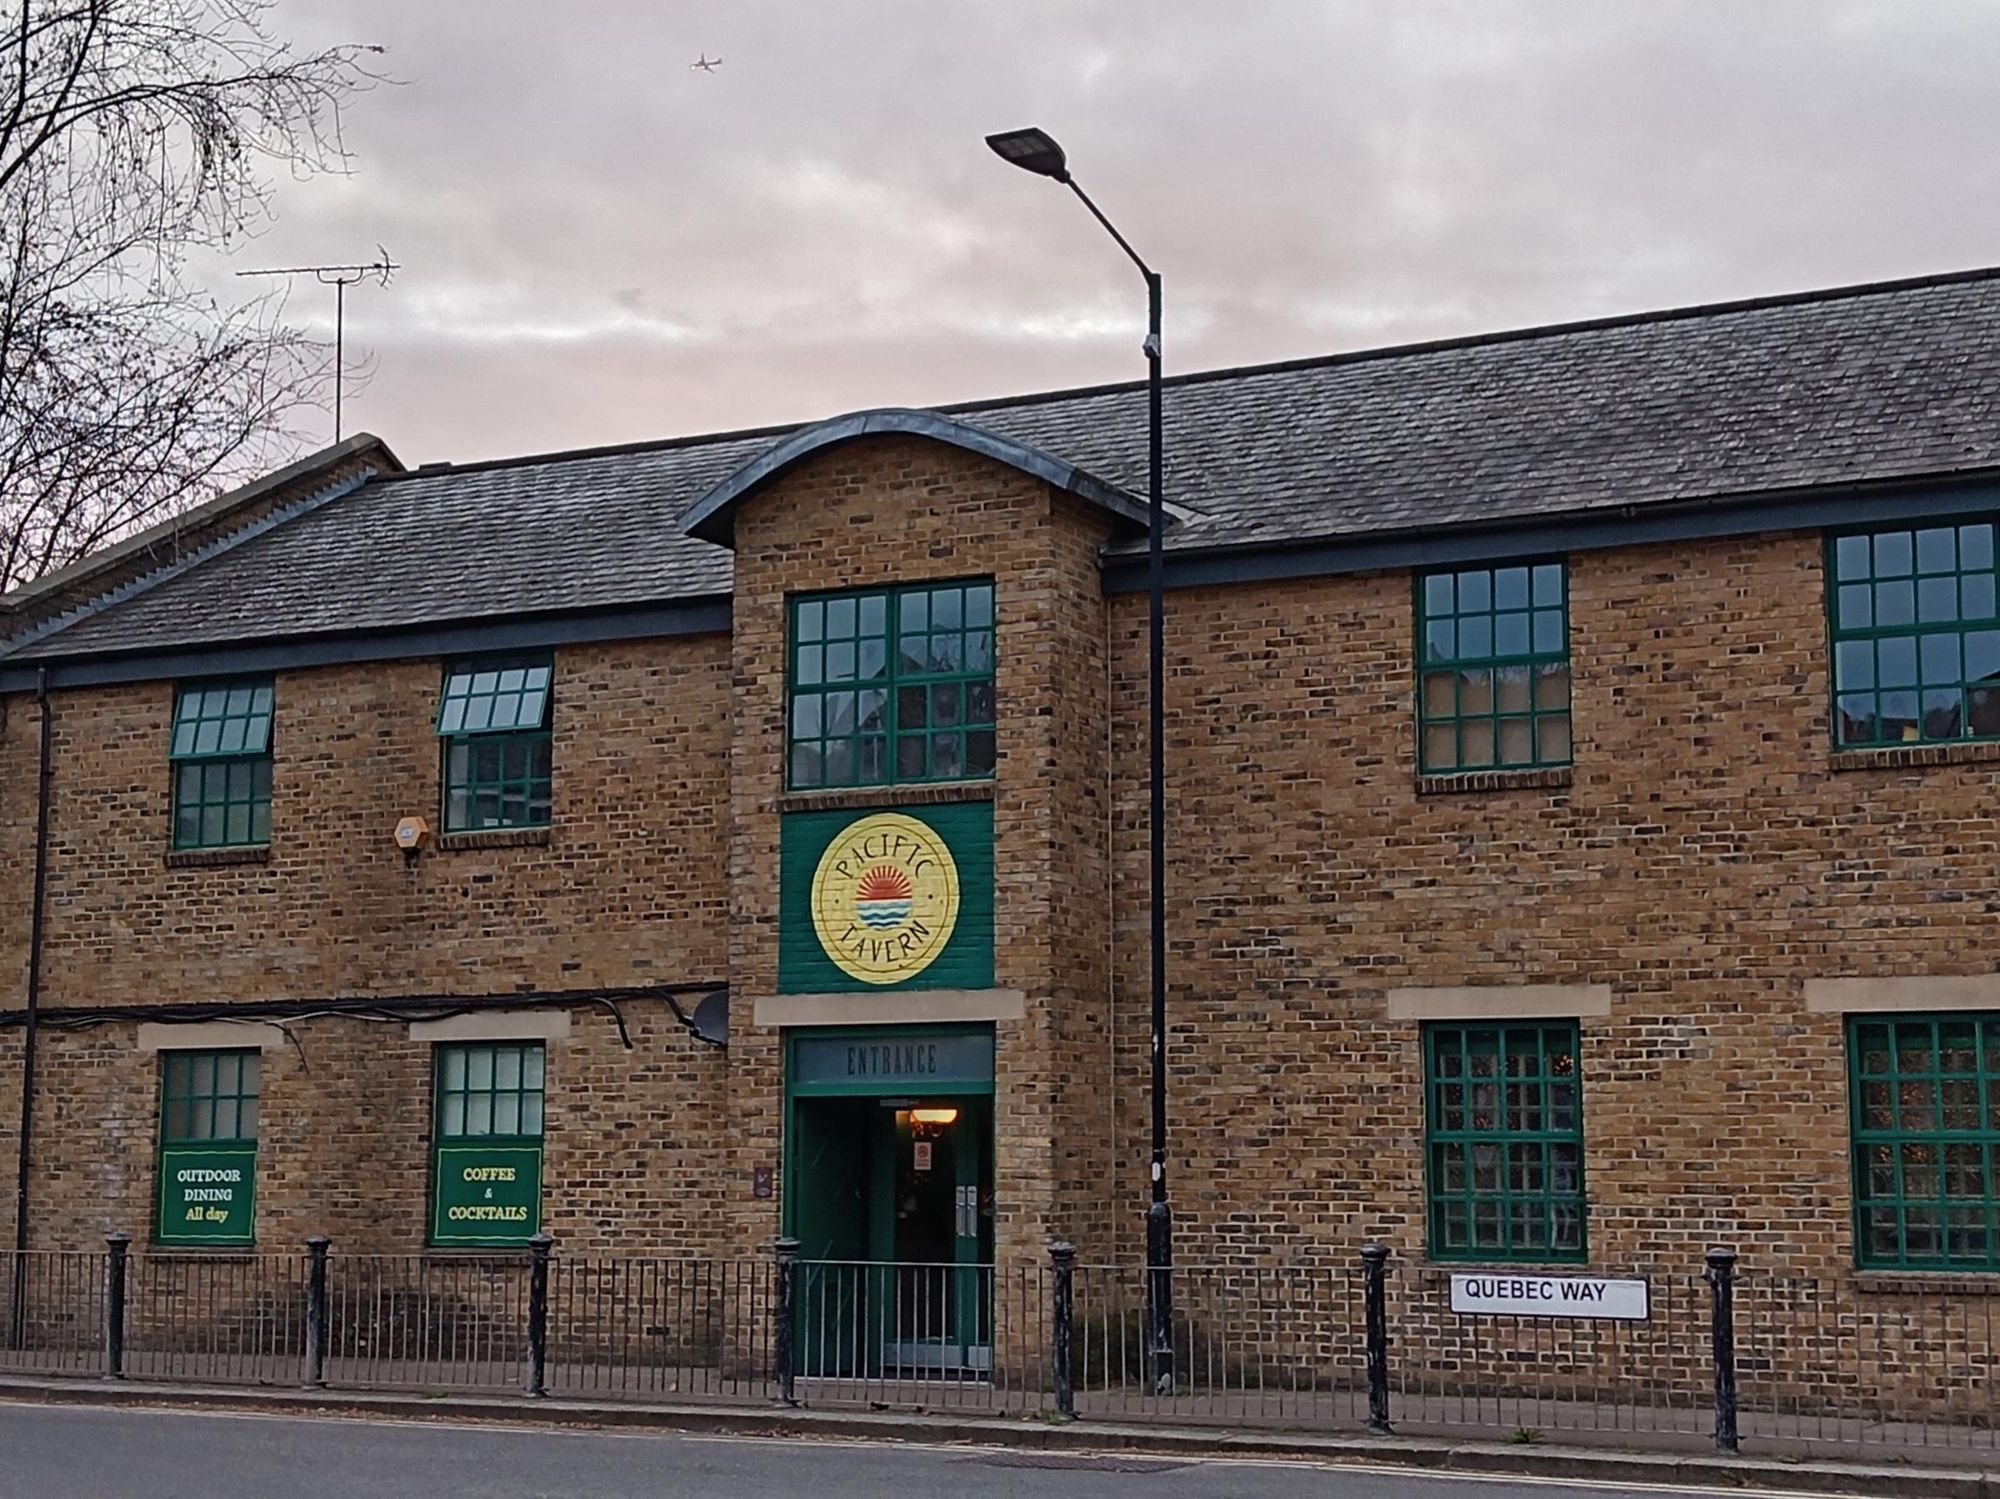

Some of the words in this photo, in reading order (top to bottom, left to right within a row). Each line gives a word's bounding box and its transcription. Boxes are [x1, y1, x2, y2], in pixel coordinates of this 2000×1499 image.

[836, 834, 934, 879] PACIFIC
[840, 919, 930, 963] TAVERN
[847, 1044, 937, 1076] ENTRANCE
[177, 1169, 242, 1182] OUTDOOR
[463, 1167, 516, 1181] COFFEE
[184, 1188, 233, 1201] DINING
[484, 1187, 493, 1199] &
[185, 1206, 204, 1221] All
[206, 1206, 229, 1224] day
[448, 1206, 528, 1221] COCKTAILS
[1465, 1279, 1553, 1300] QUEBEC
[1560, 1282, 1607, 1301] WAY
